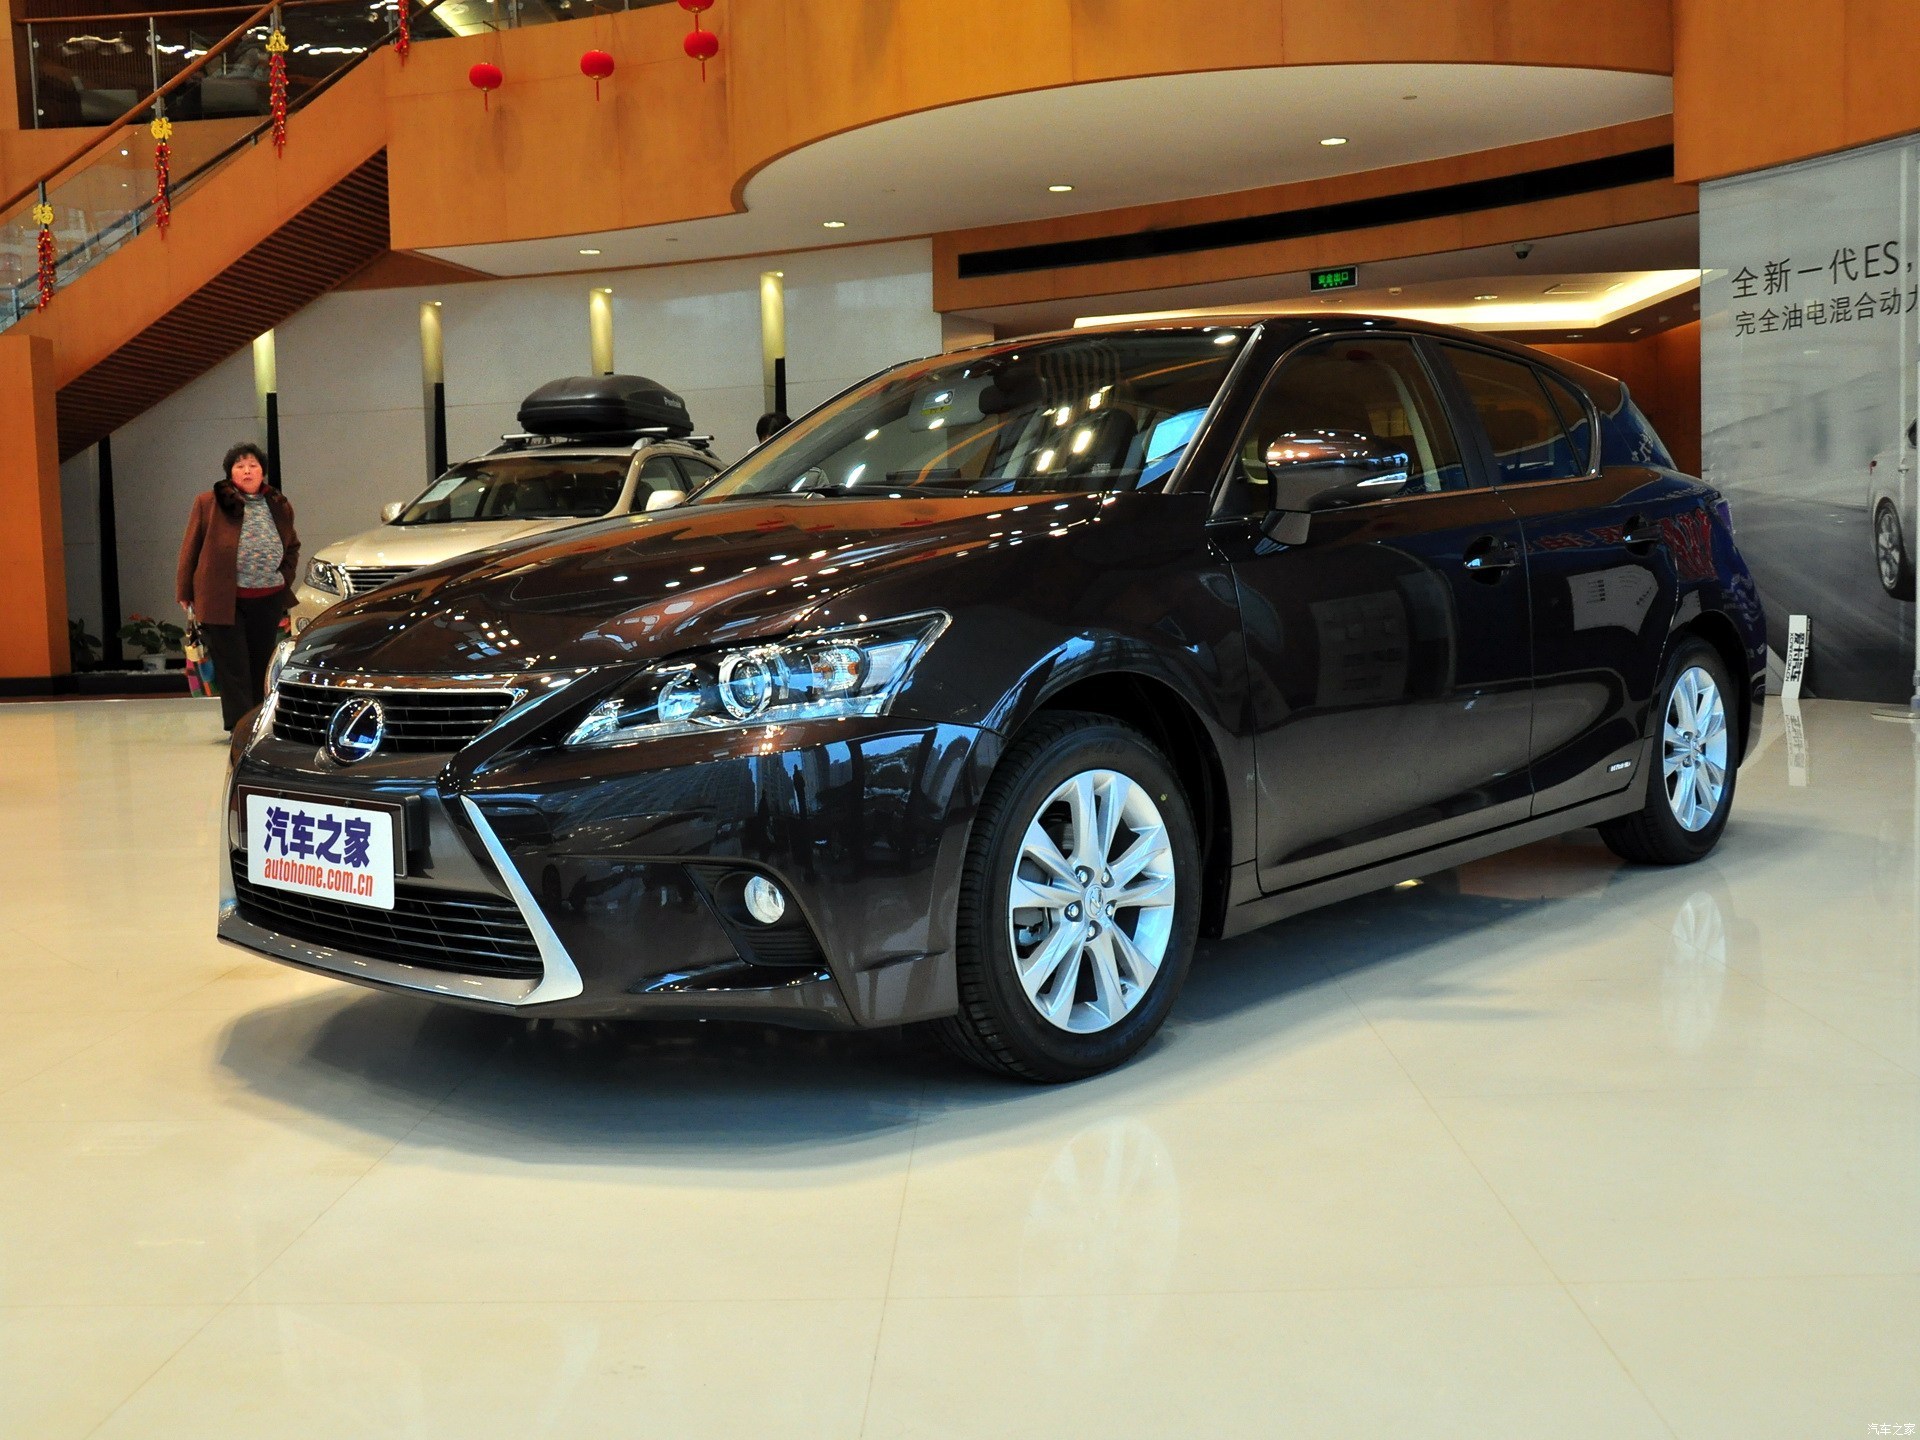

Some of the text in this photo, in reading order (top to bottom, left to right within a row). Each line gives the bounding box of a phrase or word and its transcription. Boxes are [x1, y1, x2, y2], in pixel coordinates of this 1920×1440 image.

[263, 806, 371, 868] 汽车之家
[264, 857, 373, 897] autohome.com.cn
